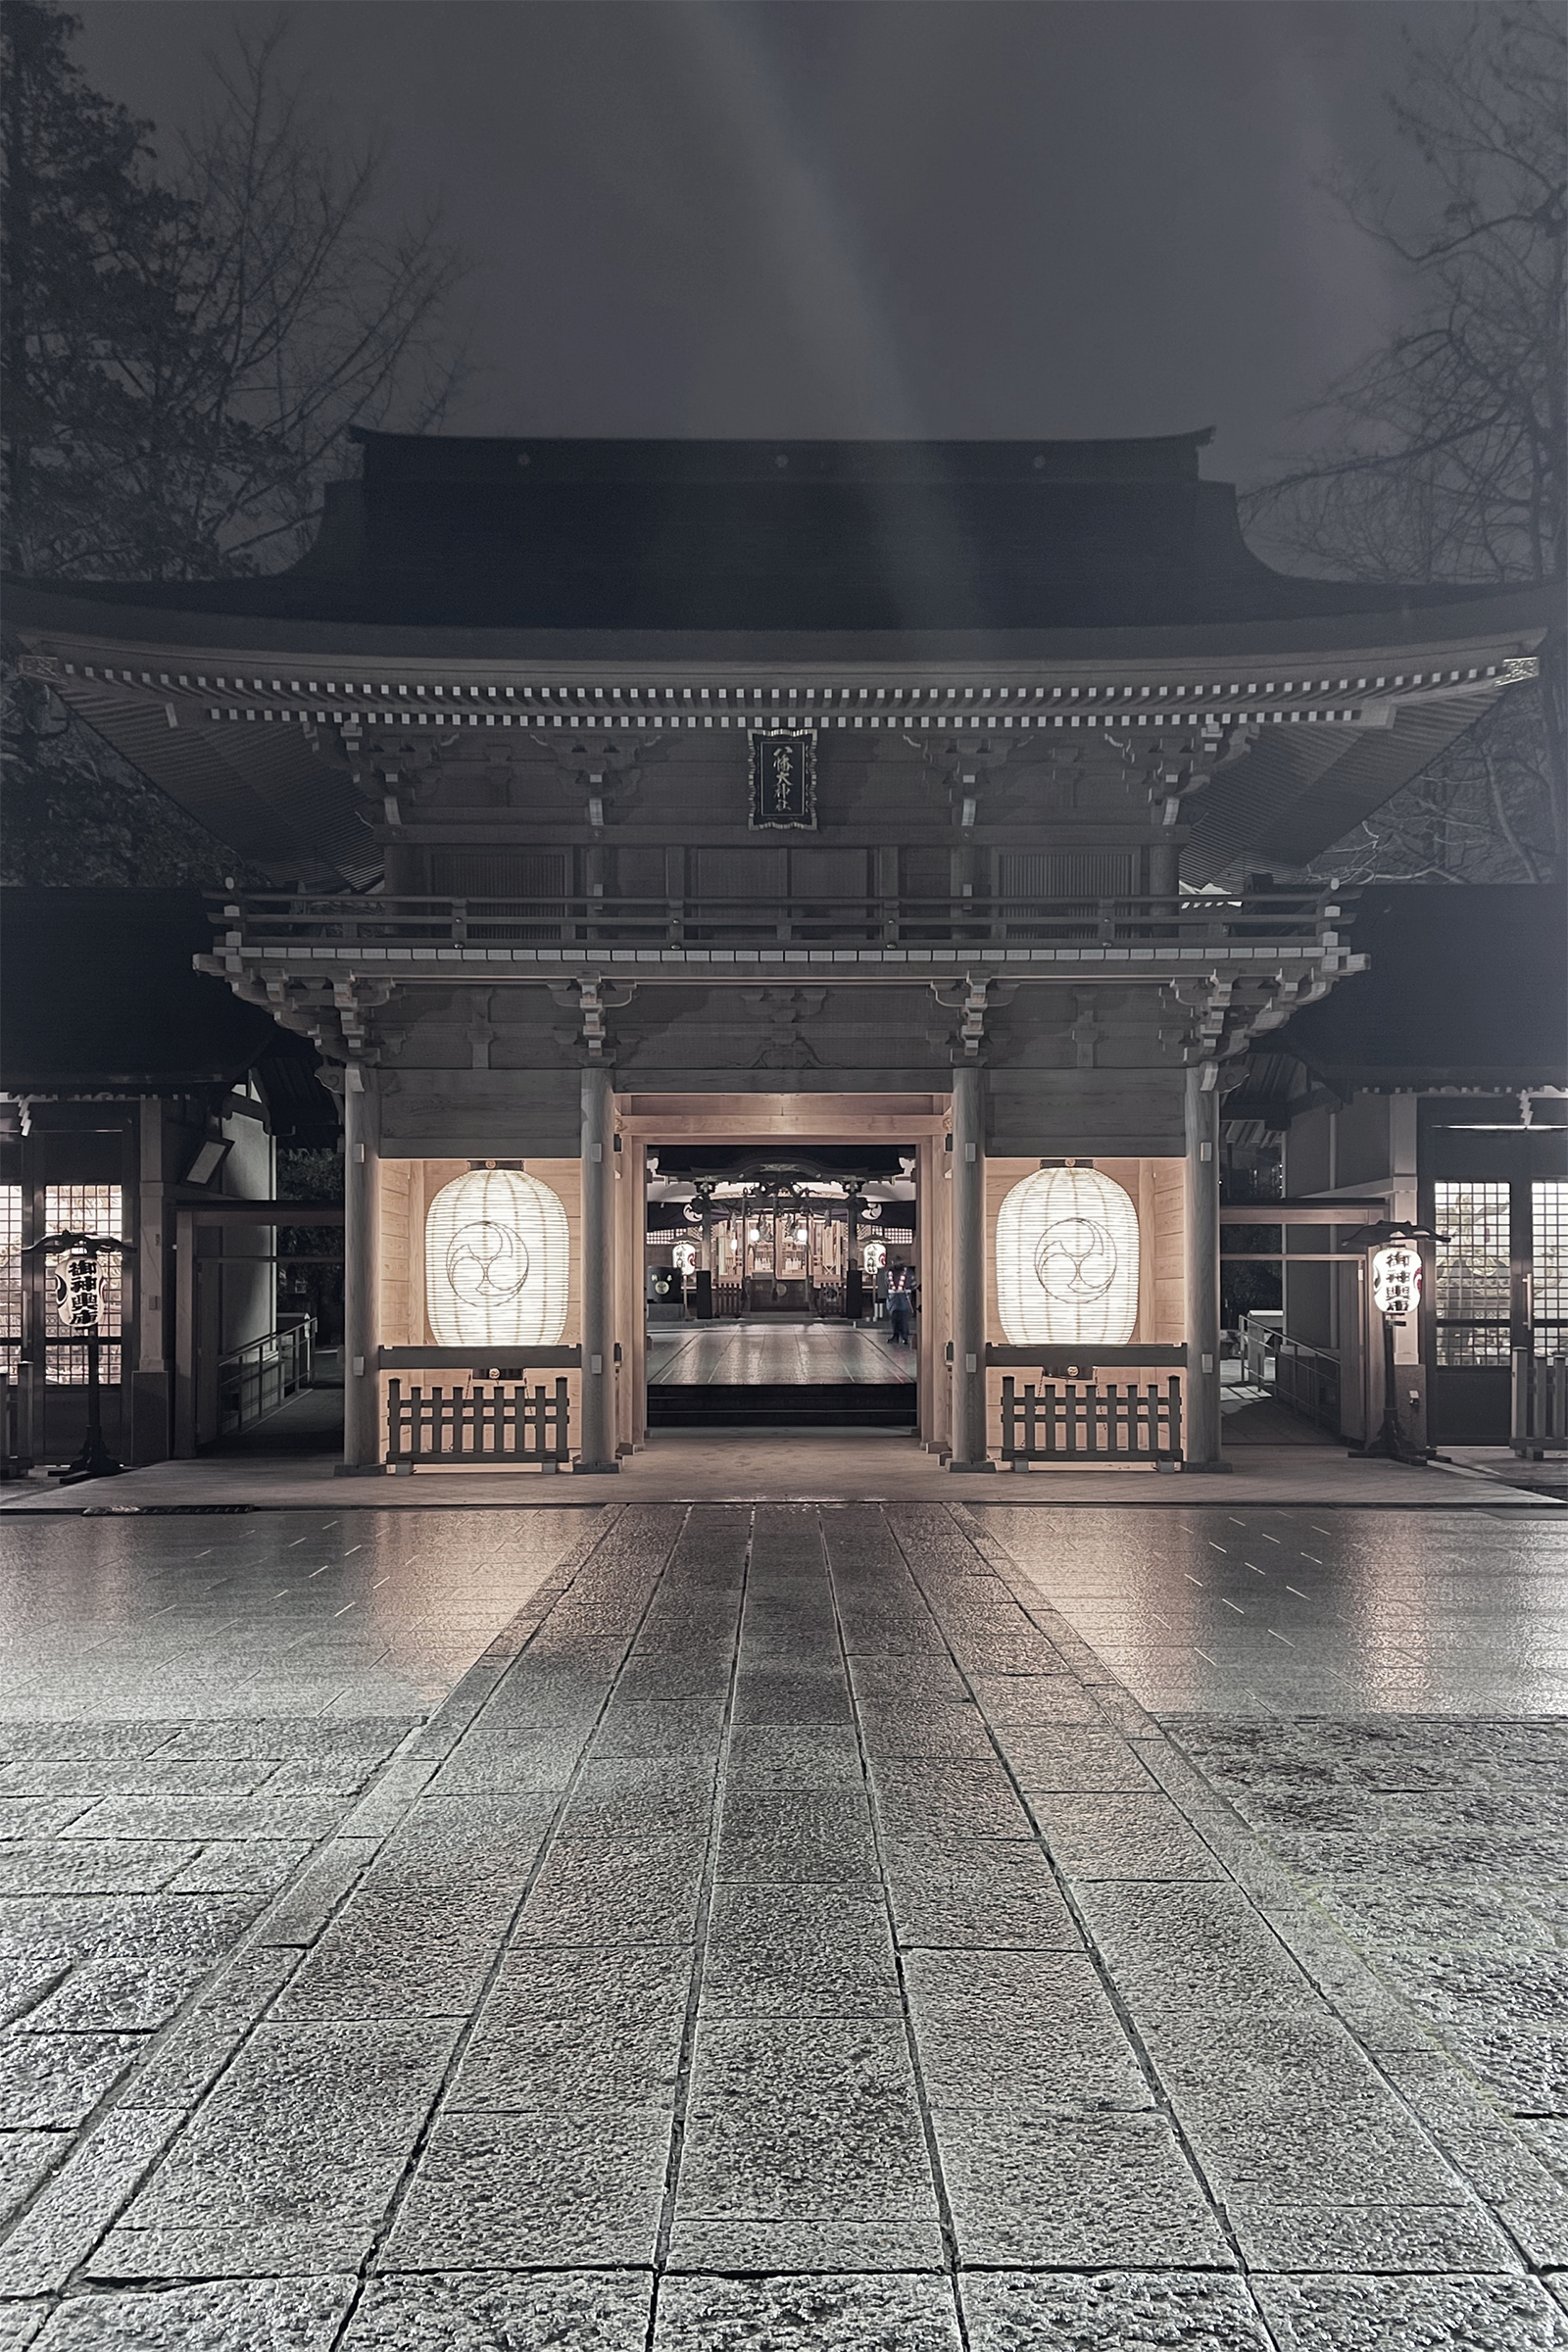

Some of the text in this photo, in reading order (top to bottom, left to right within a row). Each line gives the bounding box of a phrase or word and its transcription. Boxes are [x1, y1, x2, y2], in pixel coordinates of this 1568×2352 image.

[69, 1260, 98, 1324] 御神輿庫
[1386, 1251, 1411, 1311] 御神輿庫
